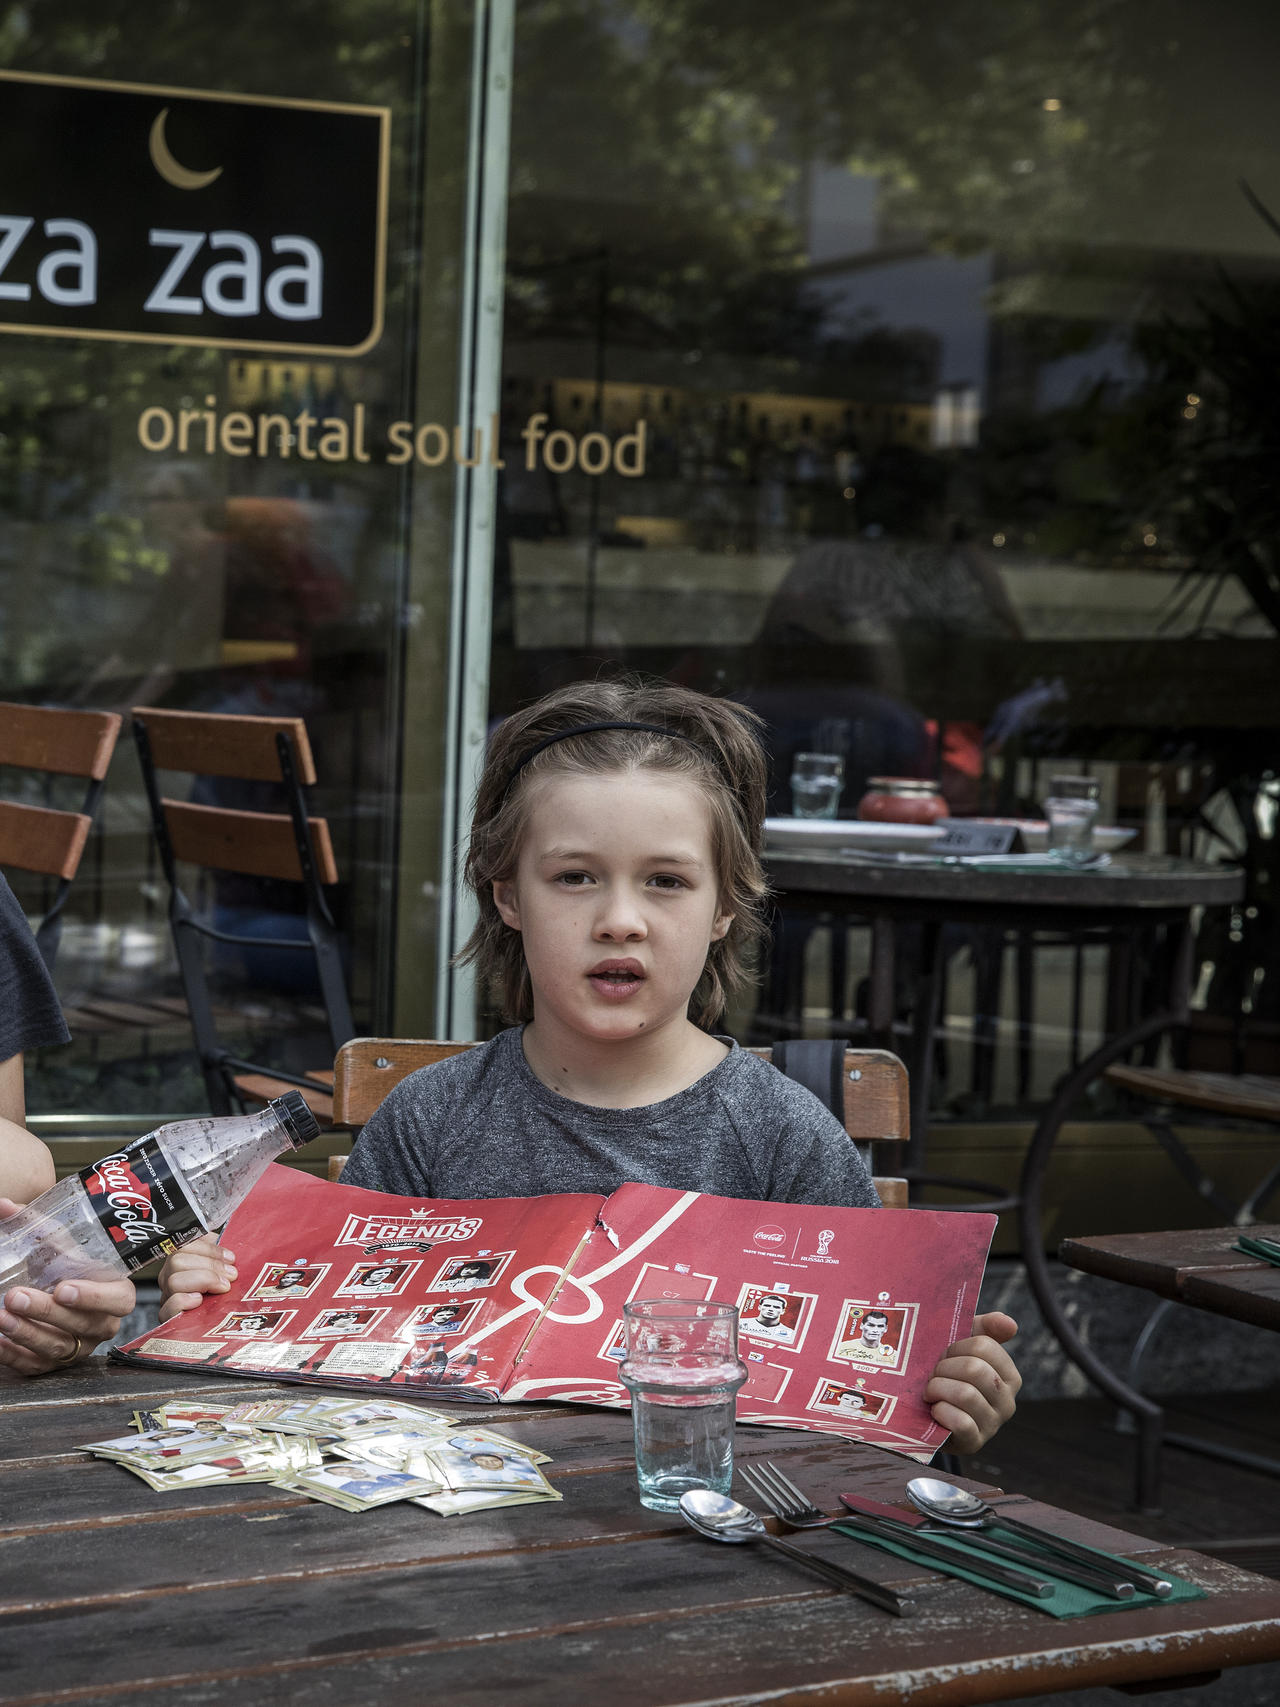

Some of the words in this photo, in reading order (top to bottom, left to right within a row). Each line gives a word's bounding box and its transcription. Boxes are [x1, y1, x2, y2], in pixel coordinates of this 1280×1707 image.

[137, 395, 370, 462] oriental
[387, 413, 505, 470] soul
[522, 413, 647, 477] food
[92, 1153, 169, 1244] Coca-Cola
[162, 1191, 175, 1211] SUCRE
[341, 1217, 478, 1244] LEGENDS
[755, 1232, 784, 1242] Coca-Cola
[662, 1290, 681, 1300] C7
